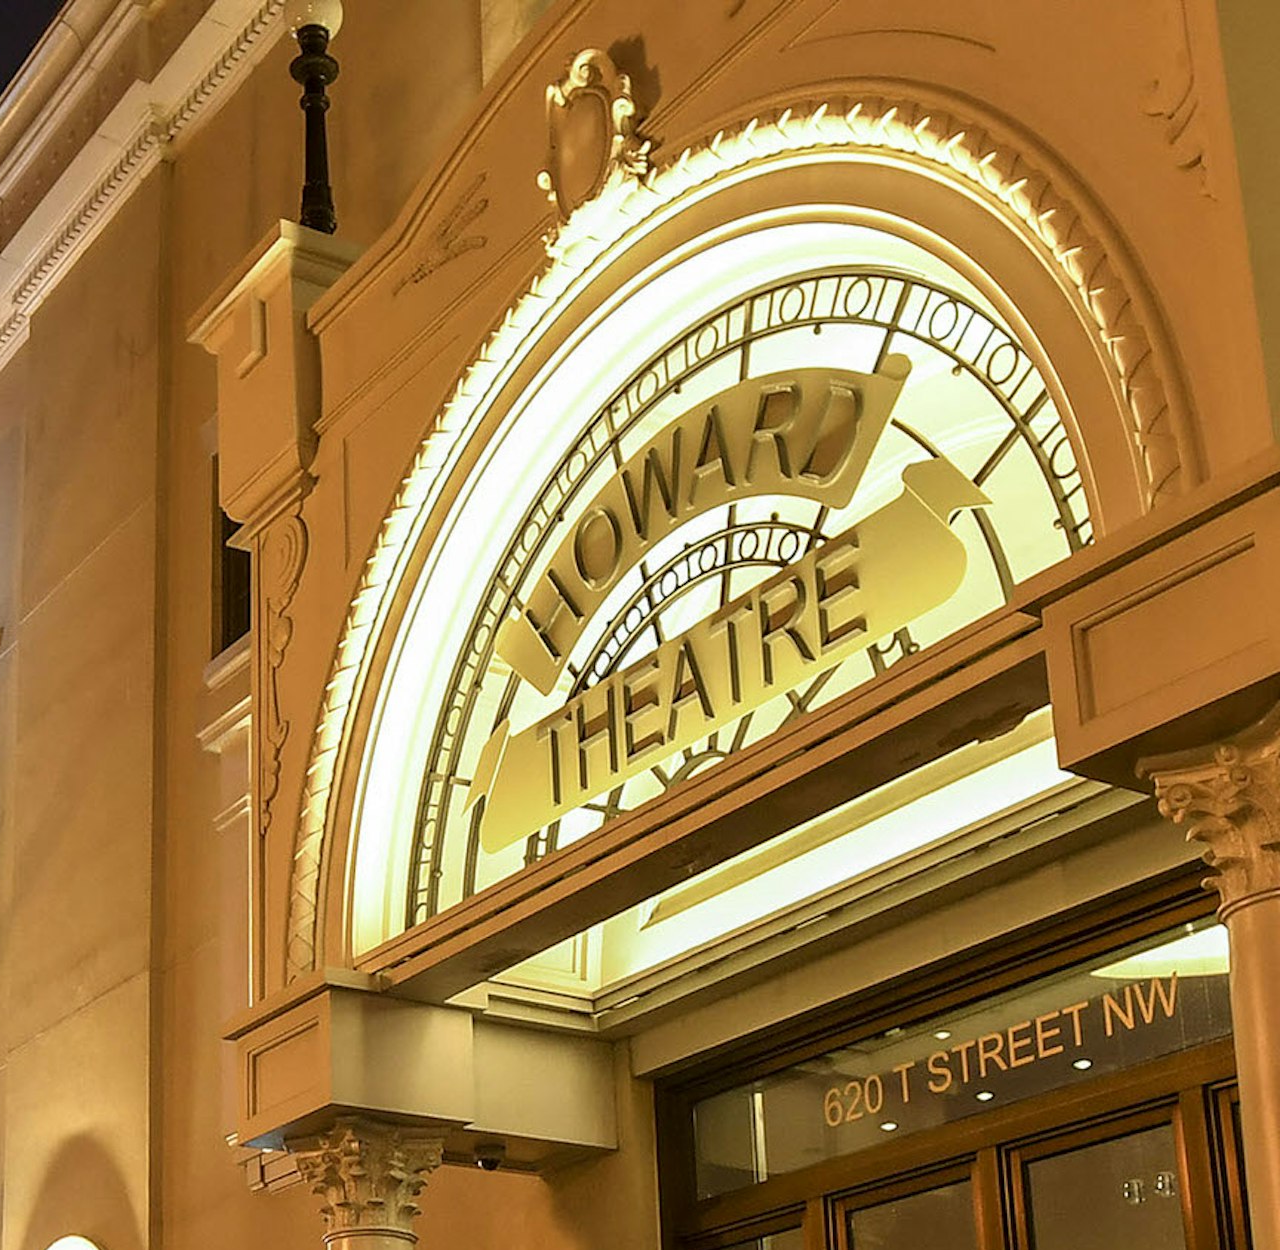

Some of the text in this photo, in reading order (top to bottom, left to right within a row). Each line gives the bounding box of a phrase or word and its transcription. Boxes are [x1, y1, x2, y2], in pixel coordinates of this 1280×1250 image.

[523, 379, 863, 663] HOWARD
[536, 530, 869, 806] THEATRE
[823, 969, 1178, 1128] 620 T STREET NW
